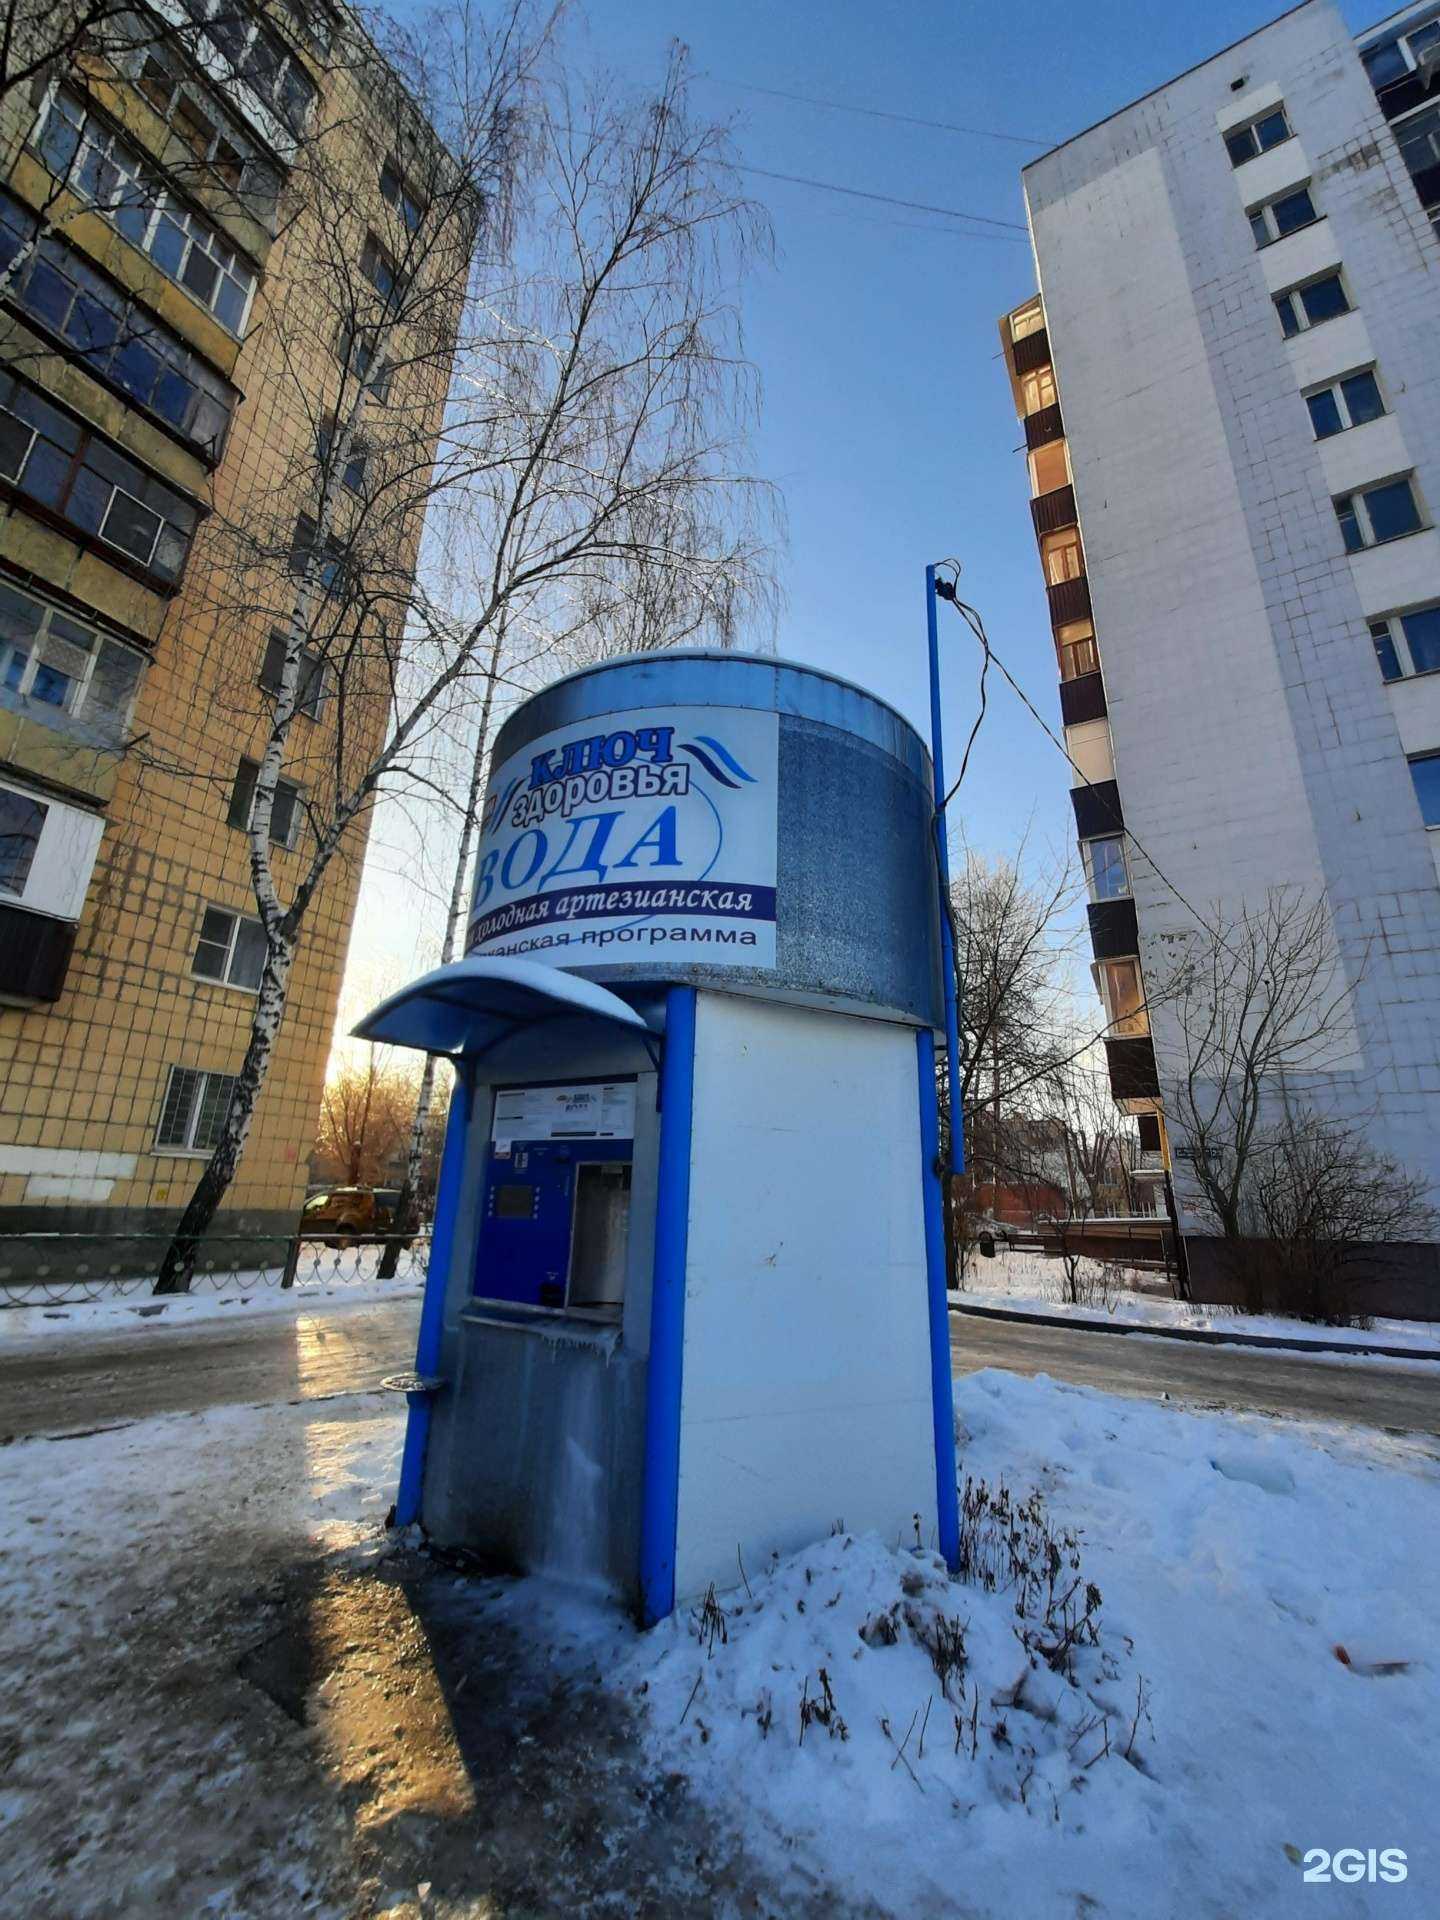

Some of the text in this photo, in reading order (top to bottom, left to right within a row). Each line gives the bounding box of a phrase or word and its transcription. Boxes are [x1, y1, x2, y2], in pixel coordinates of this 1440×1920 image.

[475, 805, 684, 908] ВОДА
[555, 887, 753, 919] артезианская
[581, 926, 757, 947] программа
